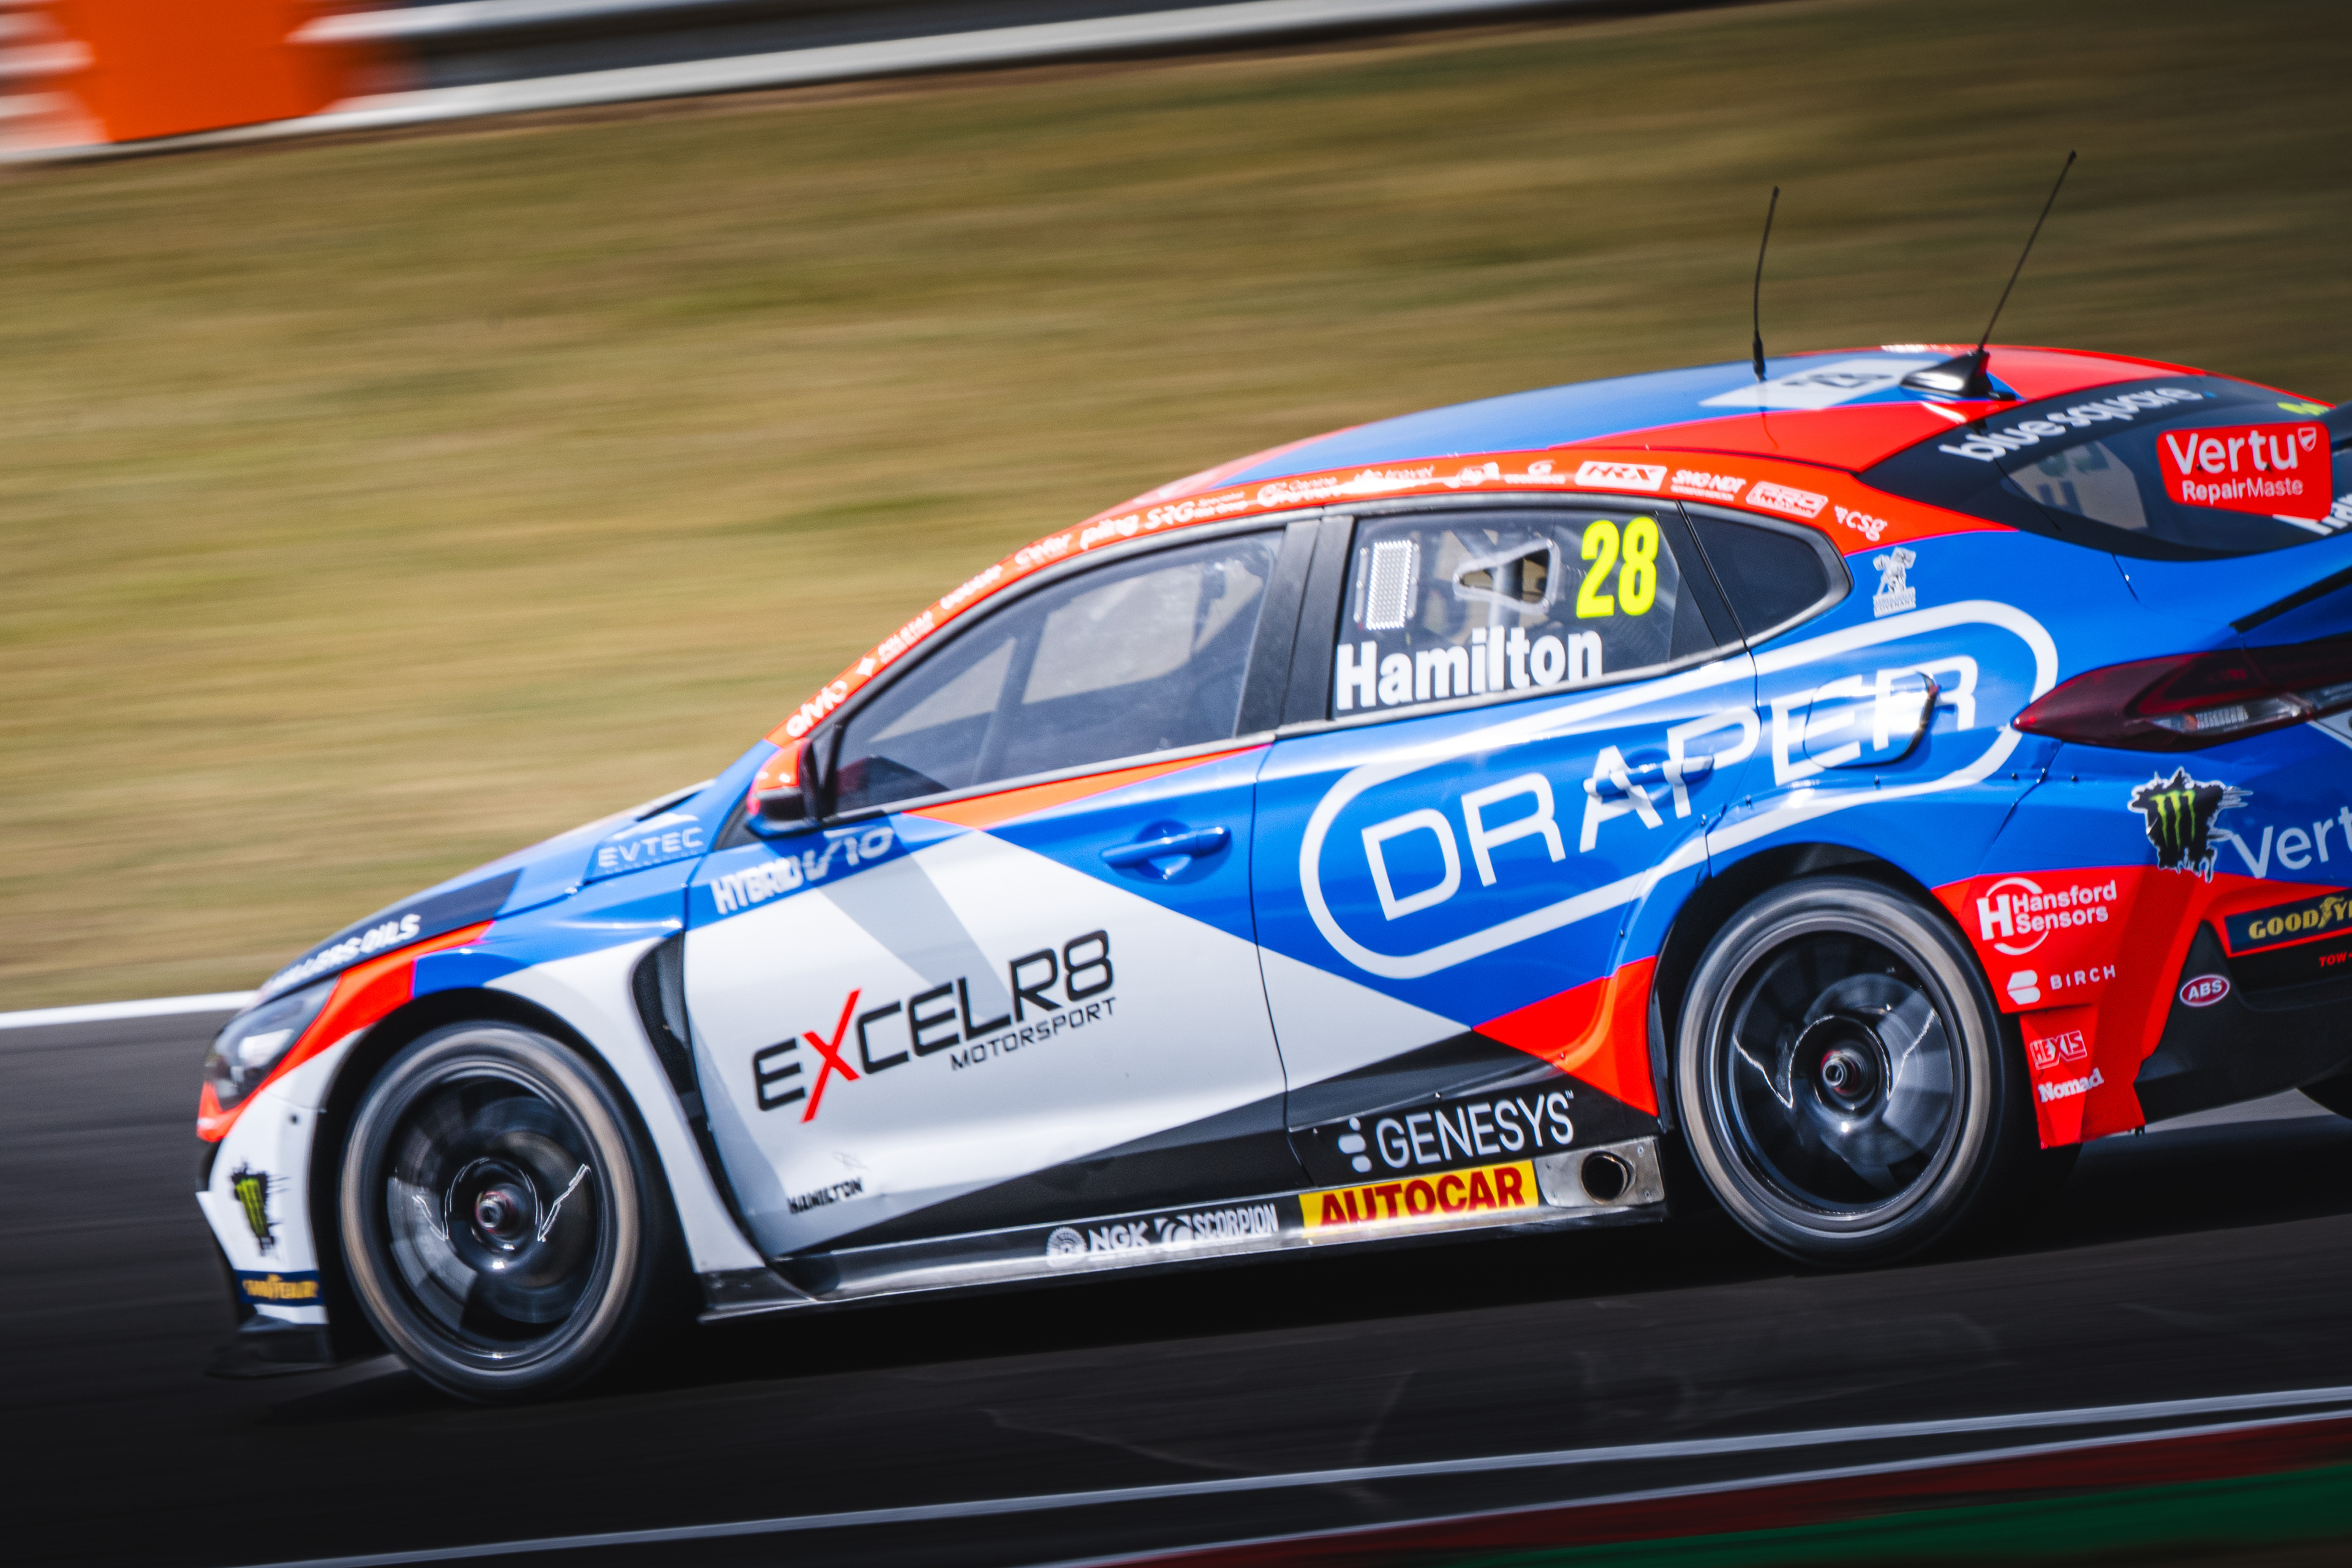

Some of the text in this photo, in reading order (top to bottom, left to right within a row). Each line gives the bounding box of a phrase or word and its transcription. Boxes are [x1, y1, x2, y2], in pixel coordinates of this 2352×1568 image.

[2166, 429, 2298, 475] Vertu
[1577, 516, 1659, 619] 28
[1336, 625, 1603, 710] Hamilton
[1360, 655, 1979, 922] DRAPER
[598, 827, 703, 867] EVTEC
[710, 856, 804, 914] HYBRID
[2012, 879, 2117, 914] Hansford
[2015, 905, 2109, 940] Sensors
[2049, 964, 2116, 997] BIRCH
[2187, 979, 2222, 1001] ABS
[751, 929, 1115, 1124] EXCELR8
[949, 997, 1117, 1071] MOTORSPORT
[2029, 1030, 2088, 1071] HEXIS
[2037, 1067, 2105, 1103] Nomad
[1375, 1091, 1575, 1169] GENESYS
[1320, 1166, 1527, 1228] AUTOCAR
[1088, 1202, 1280, 1254] NGK SCORPION
